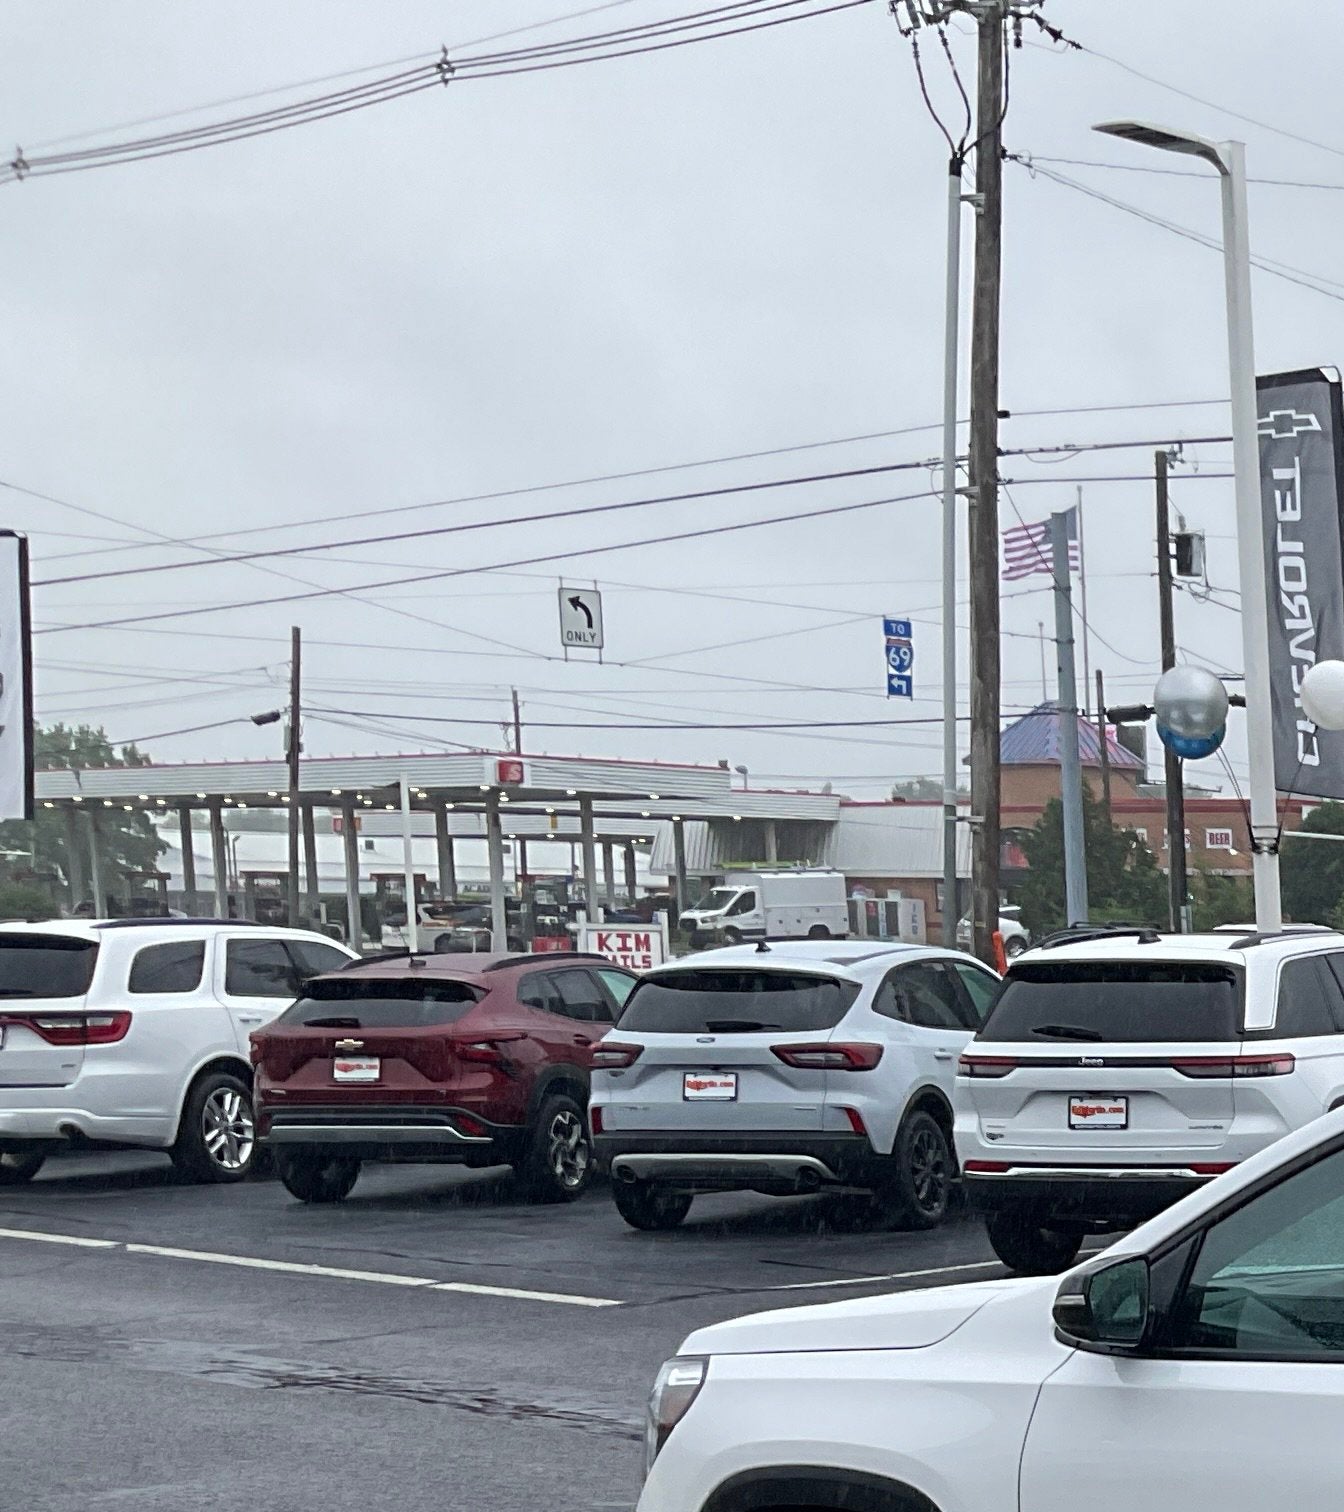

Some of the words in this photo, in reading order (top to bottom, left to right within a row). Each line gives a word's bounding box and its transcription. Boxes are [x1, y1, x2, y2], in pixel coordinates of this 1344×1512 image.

[890, 623, 905, 634] TO
[566, 630, 596, 642] ONLY
[889, 647, 910, 666] 69
[1209, 832, 1230, 845] BEER
[597, 933, 651, 953] KIM
[605, 955, 652, 969] AILS
